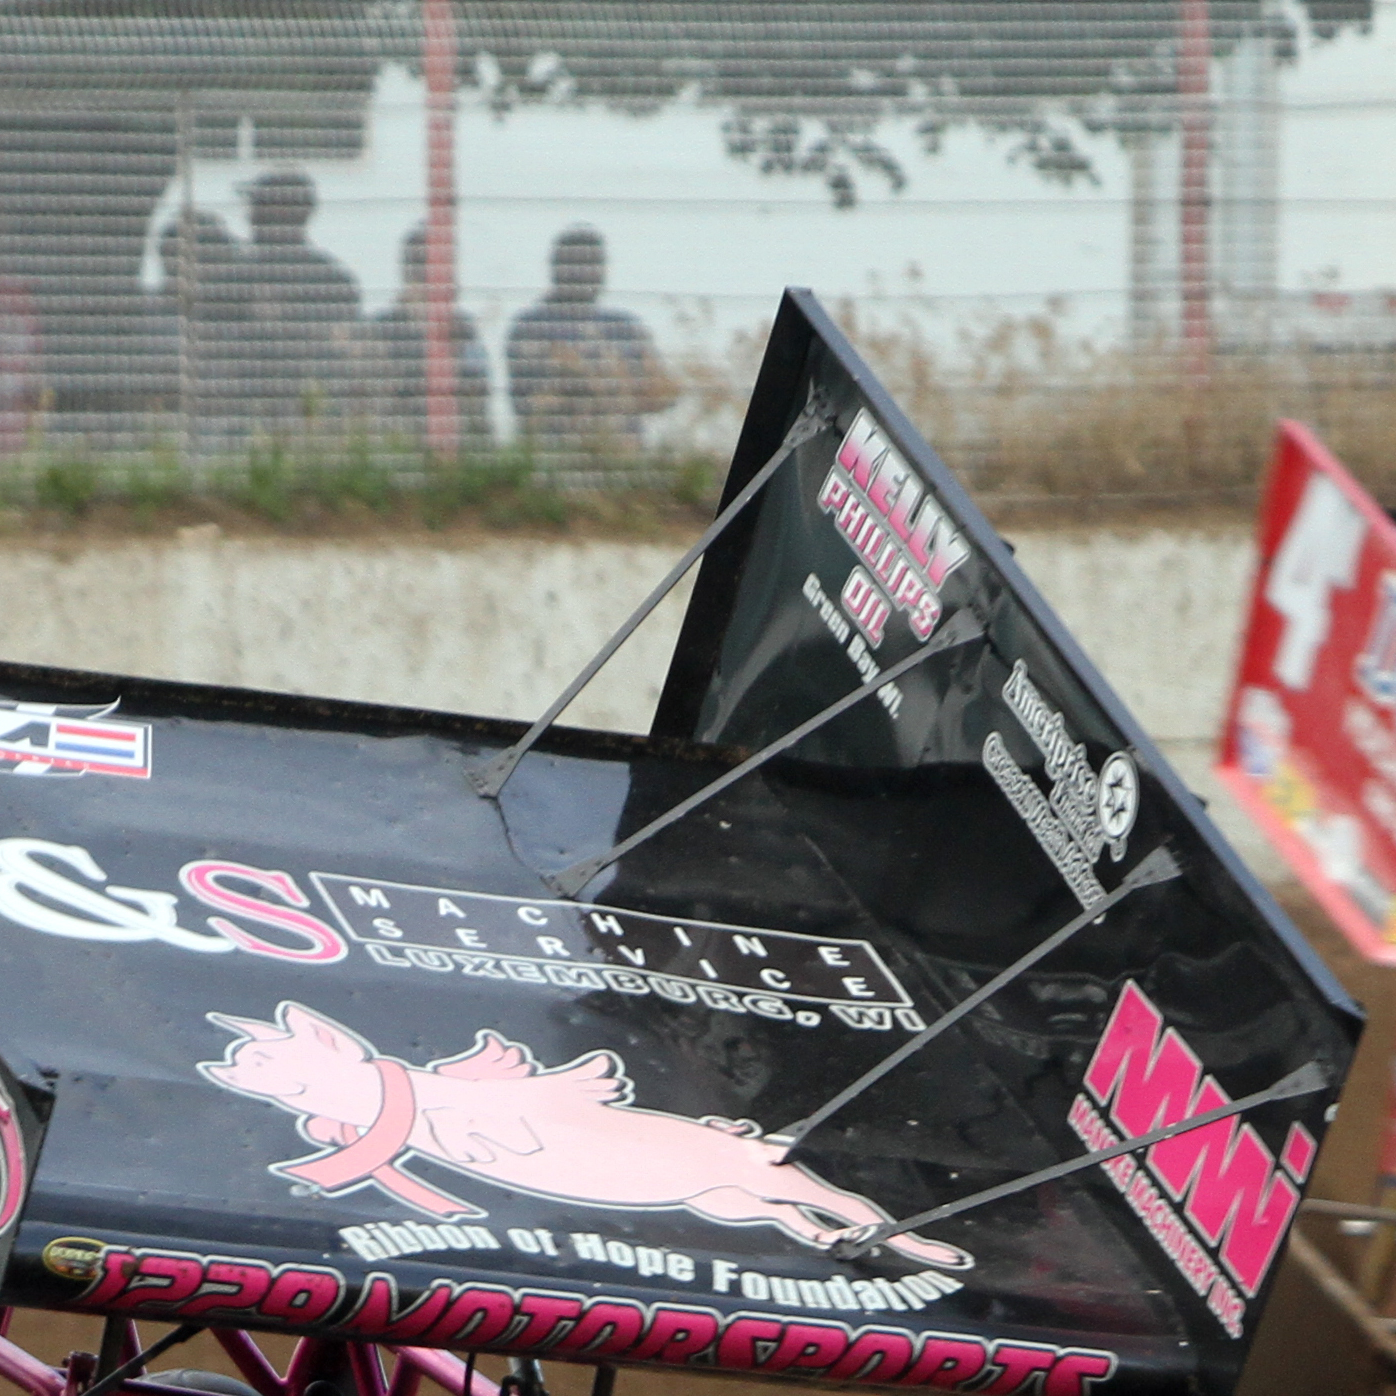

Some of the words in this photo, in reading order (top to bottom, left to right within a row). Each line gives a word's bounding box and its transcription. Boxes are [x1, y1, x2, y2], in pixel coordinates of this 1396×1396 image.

[835, 407, 970, 592] KELLY
[817, 464, 942, 641] PHILLIPS
[803, 572, 850, 644] Green
[841, 565, 891, 649] OIL
[349, 885, 849, 968] MACHINE
[373, 918, 875, 998] SERVICE
[829, 1003, 927, 1032] WI
[339, 1220, 501, 1262] Ribbon
[507, 1228, 559, 1256] of
[569, 1232, 695, 1282] Hope
[713, 1258, 965, 1311] Foundation
[1124, 1170, 1220, 1297] MACHINERY
